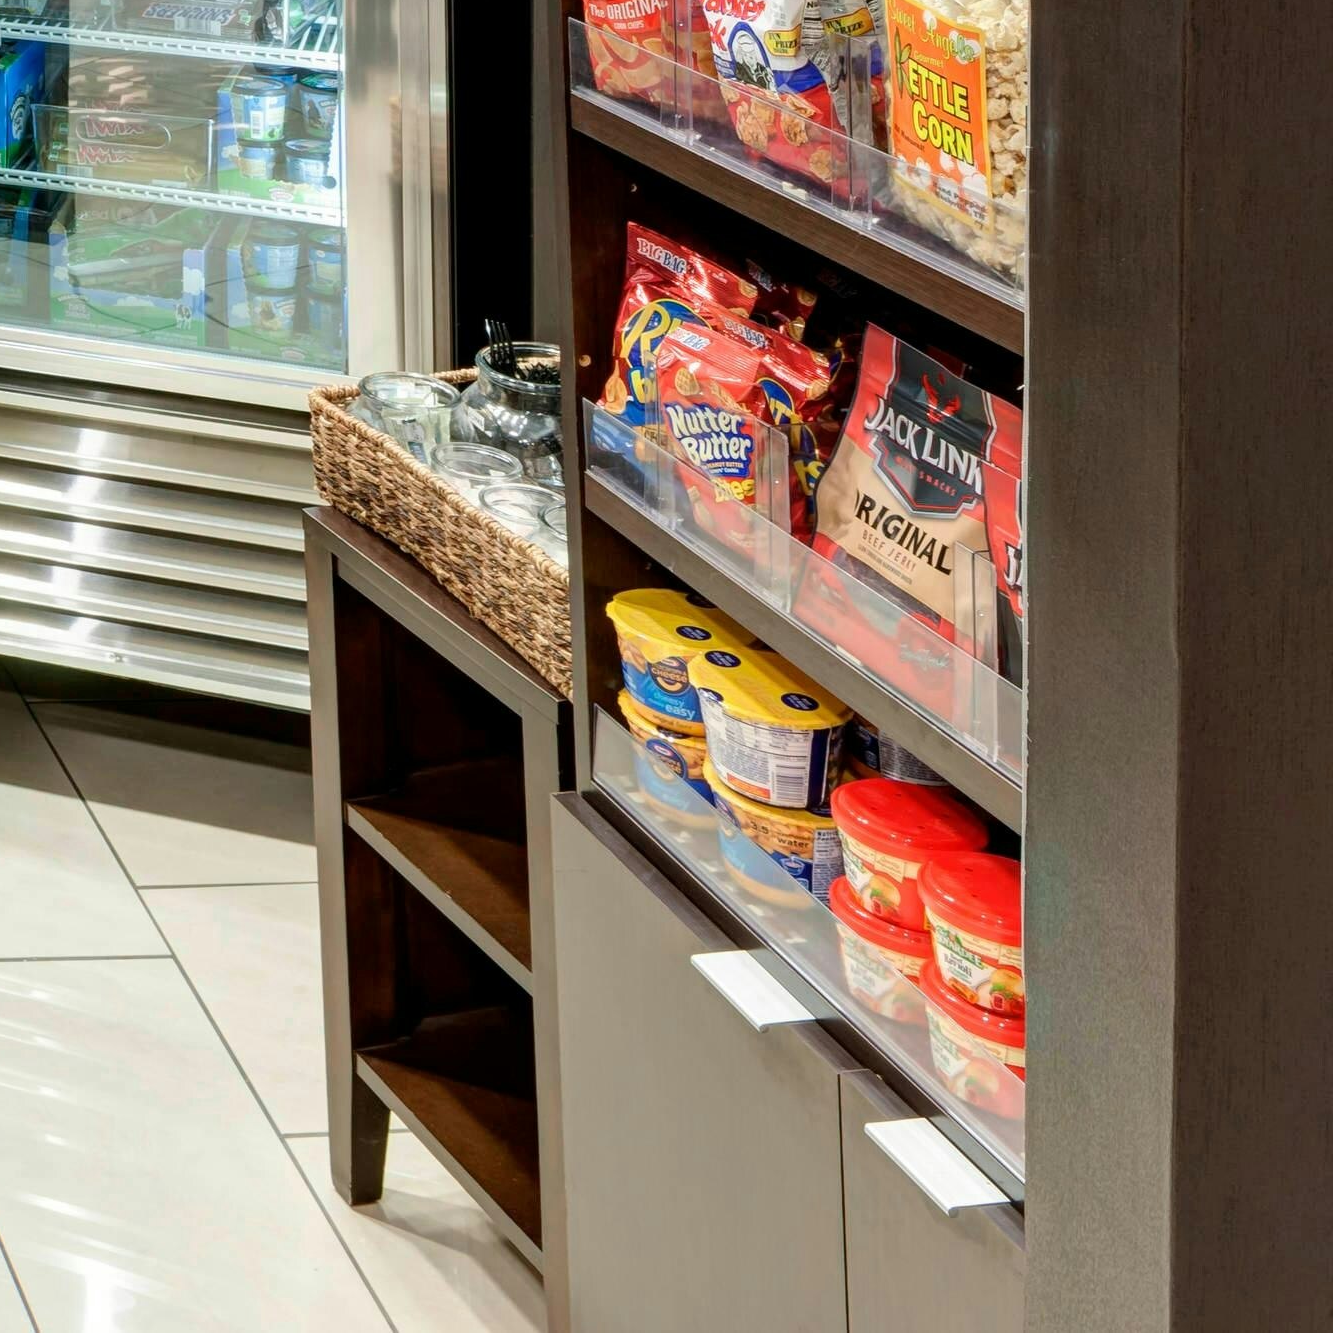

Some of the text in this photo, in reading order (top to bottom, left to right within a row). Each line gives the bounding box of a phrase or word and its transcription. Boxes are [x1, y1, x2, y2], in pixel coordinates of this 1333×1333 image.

[589, 3, 606, 19] The
[613, 20, 646, 31] CORN CHIPS
[921, 19, 975, 63] Angels
[912, 100, 975, 166] CORN
[636, 237, 687, 275] BIG BAG
[666, 404, 742, 439] Nutter
[680, 431, 752, 466] Butter
[864, 395, 983, 496] JACK LINK
[918, 468, 958, 498] SNACKS
[854, 489, 953, 577] RIGINAL
[862, 529, 885, 552] BEEF
[886, 546, 917, 572] JERKY
[664, 704, 696, 721] easy
[777, 837, 810, 848] water
